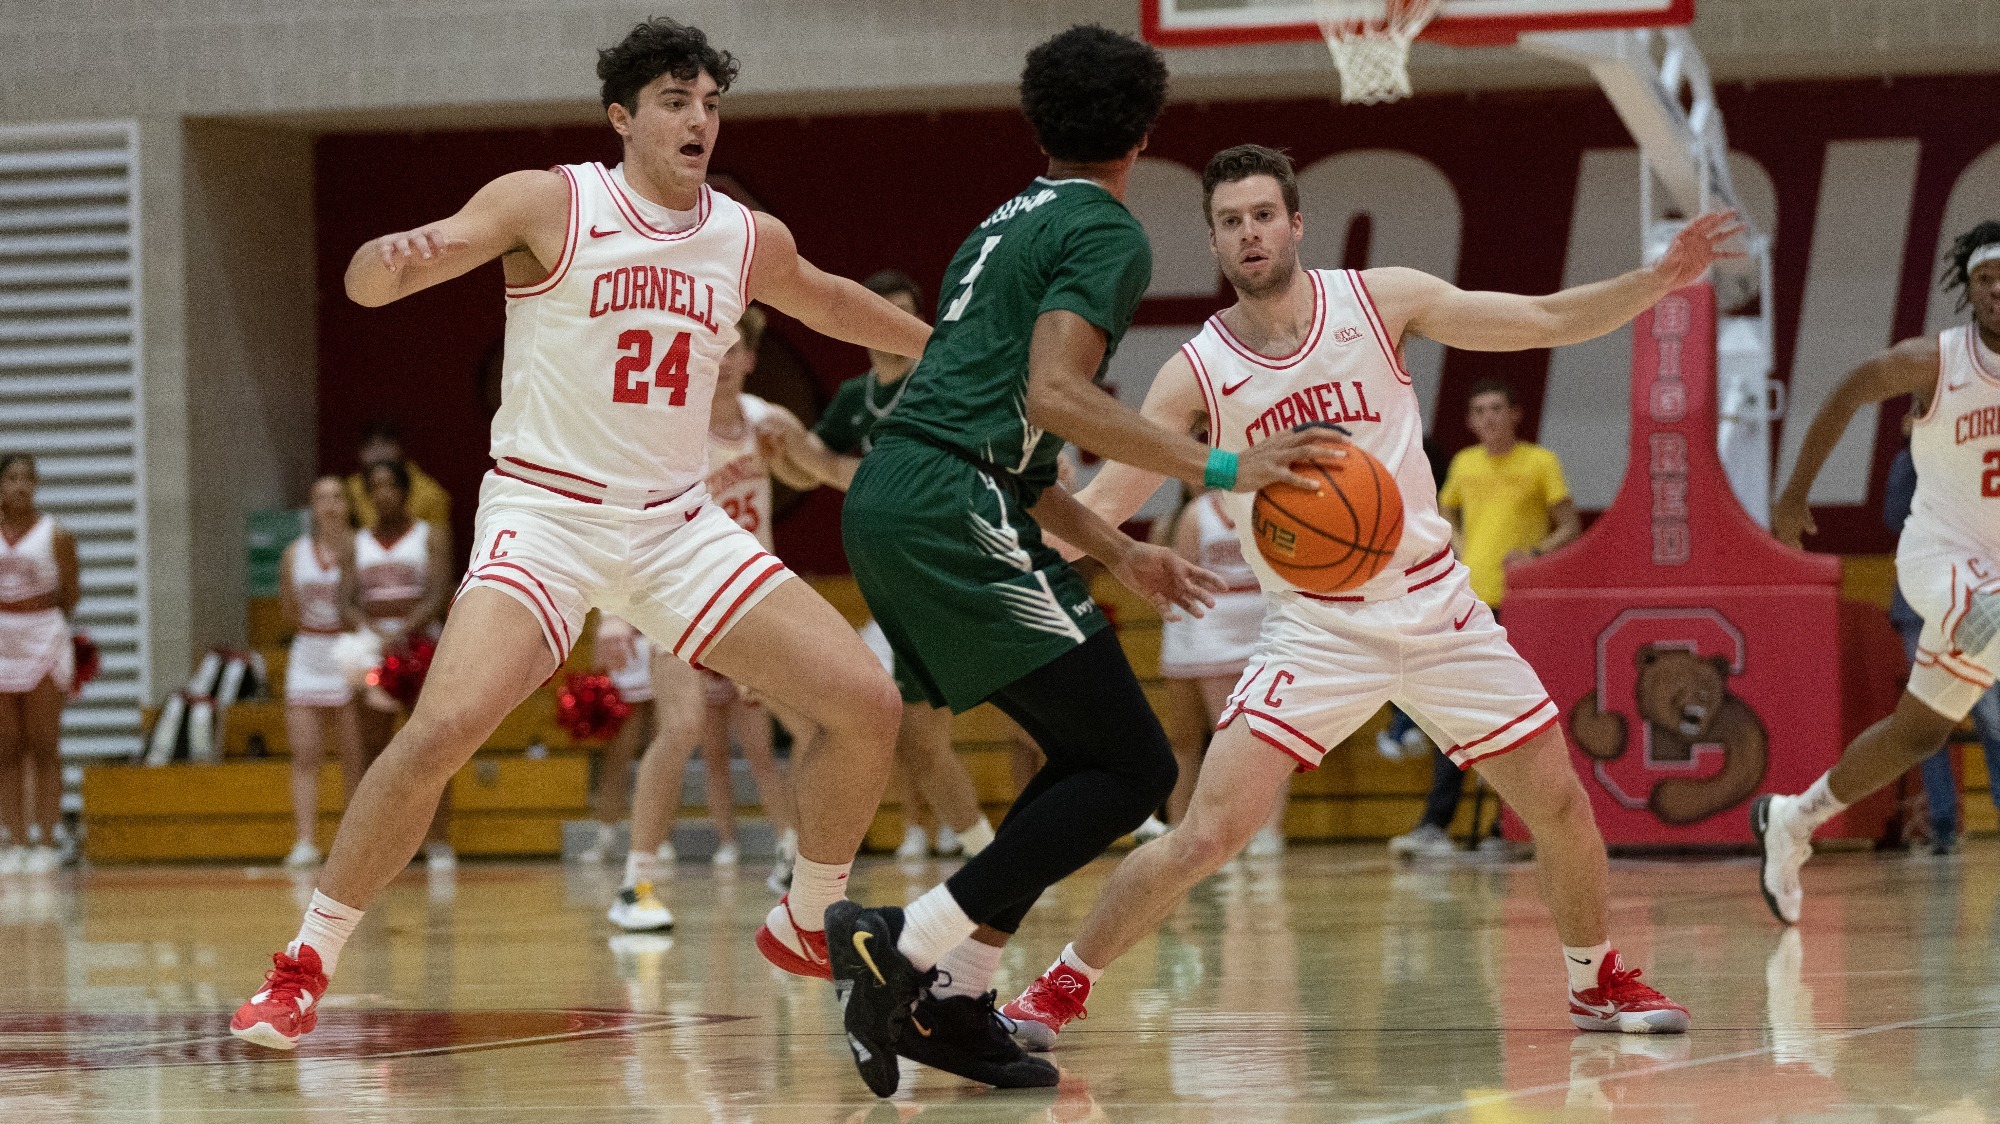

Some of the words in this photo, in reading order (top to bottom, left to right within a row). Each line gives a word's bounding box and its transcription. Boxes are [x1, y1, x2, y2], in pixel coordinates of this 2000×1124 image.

[589, 265, 719, 335] CORNELL
[612, 329, 691, 406] 24
[1650, 296, 1691, 423] BIG
[1245, 381, 1382, 447] CORNELL
[1955, 405, 2000, 446] COR
[1650, 432, 1692, 566] RED
[490, 529, 518, 560] C
[1264, 669, 1295, 708] C
